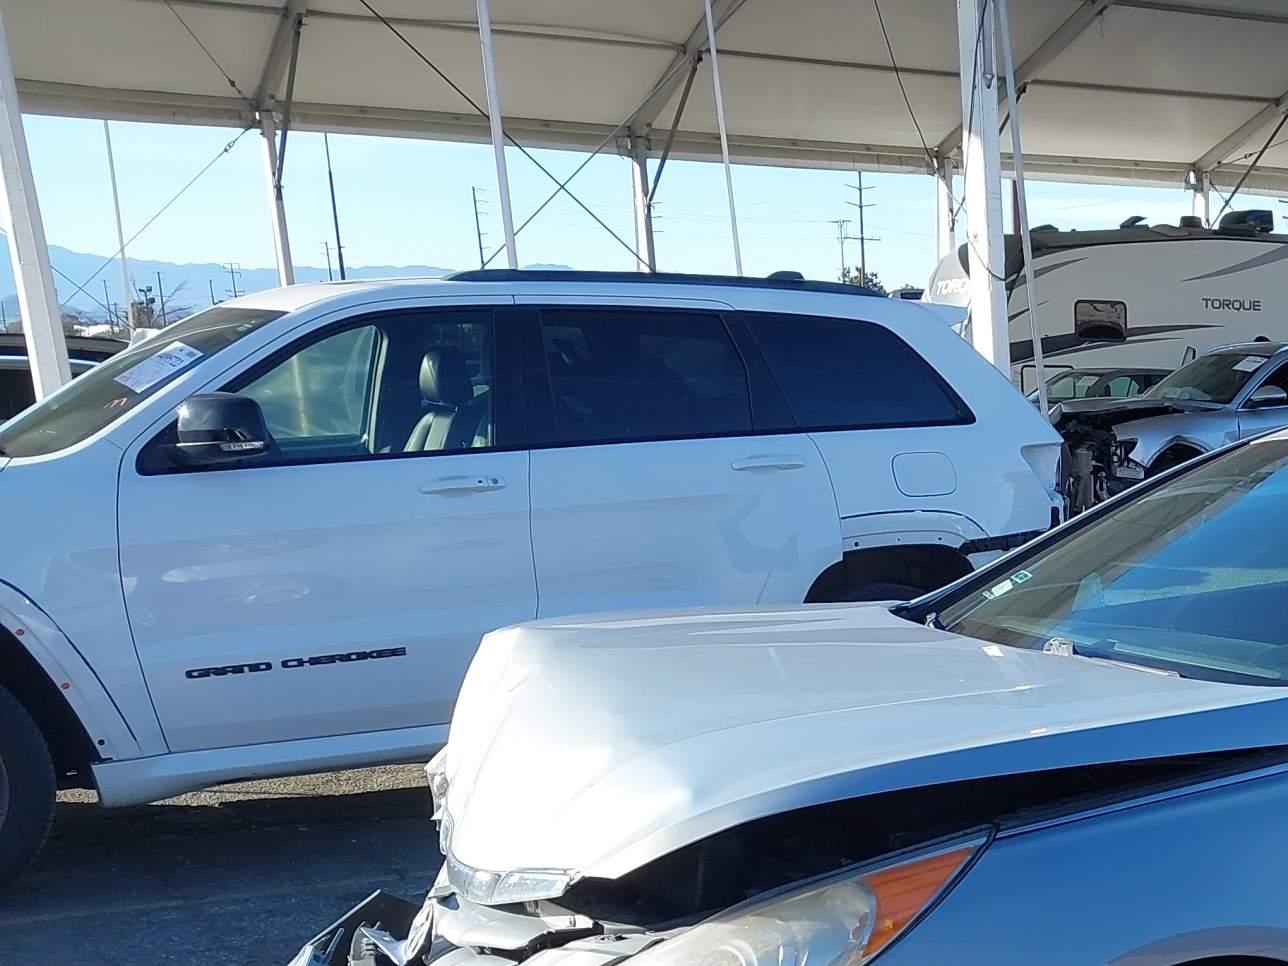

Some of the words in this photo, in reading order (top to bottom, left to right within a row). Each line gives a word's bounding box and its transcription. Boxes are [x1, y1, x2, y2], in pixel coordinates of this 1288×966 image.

[1201, 297, 1262, 312] TORQUE
[185, 661, 273, 680] GRAND
[280, 646, 408, 670] CHEROKEE
